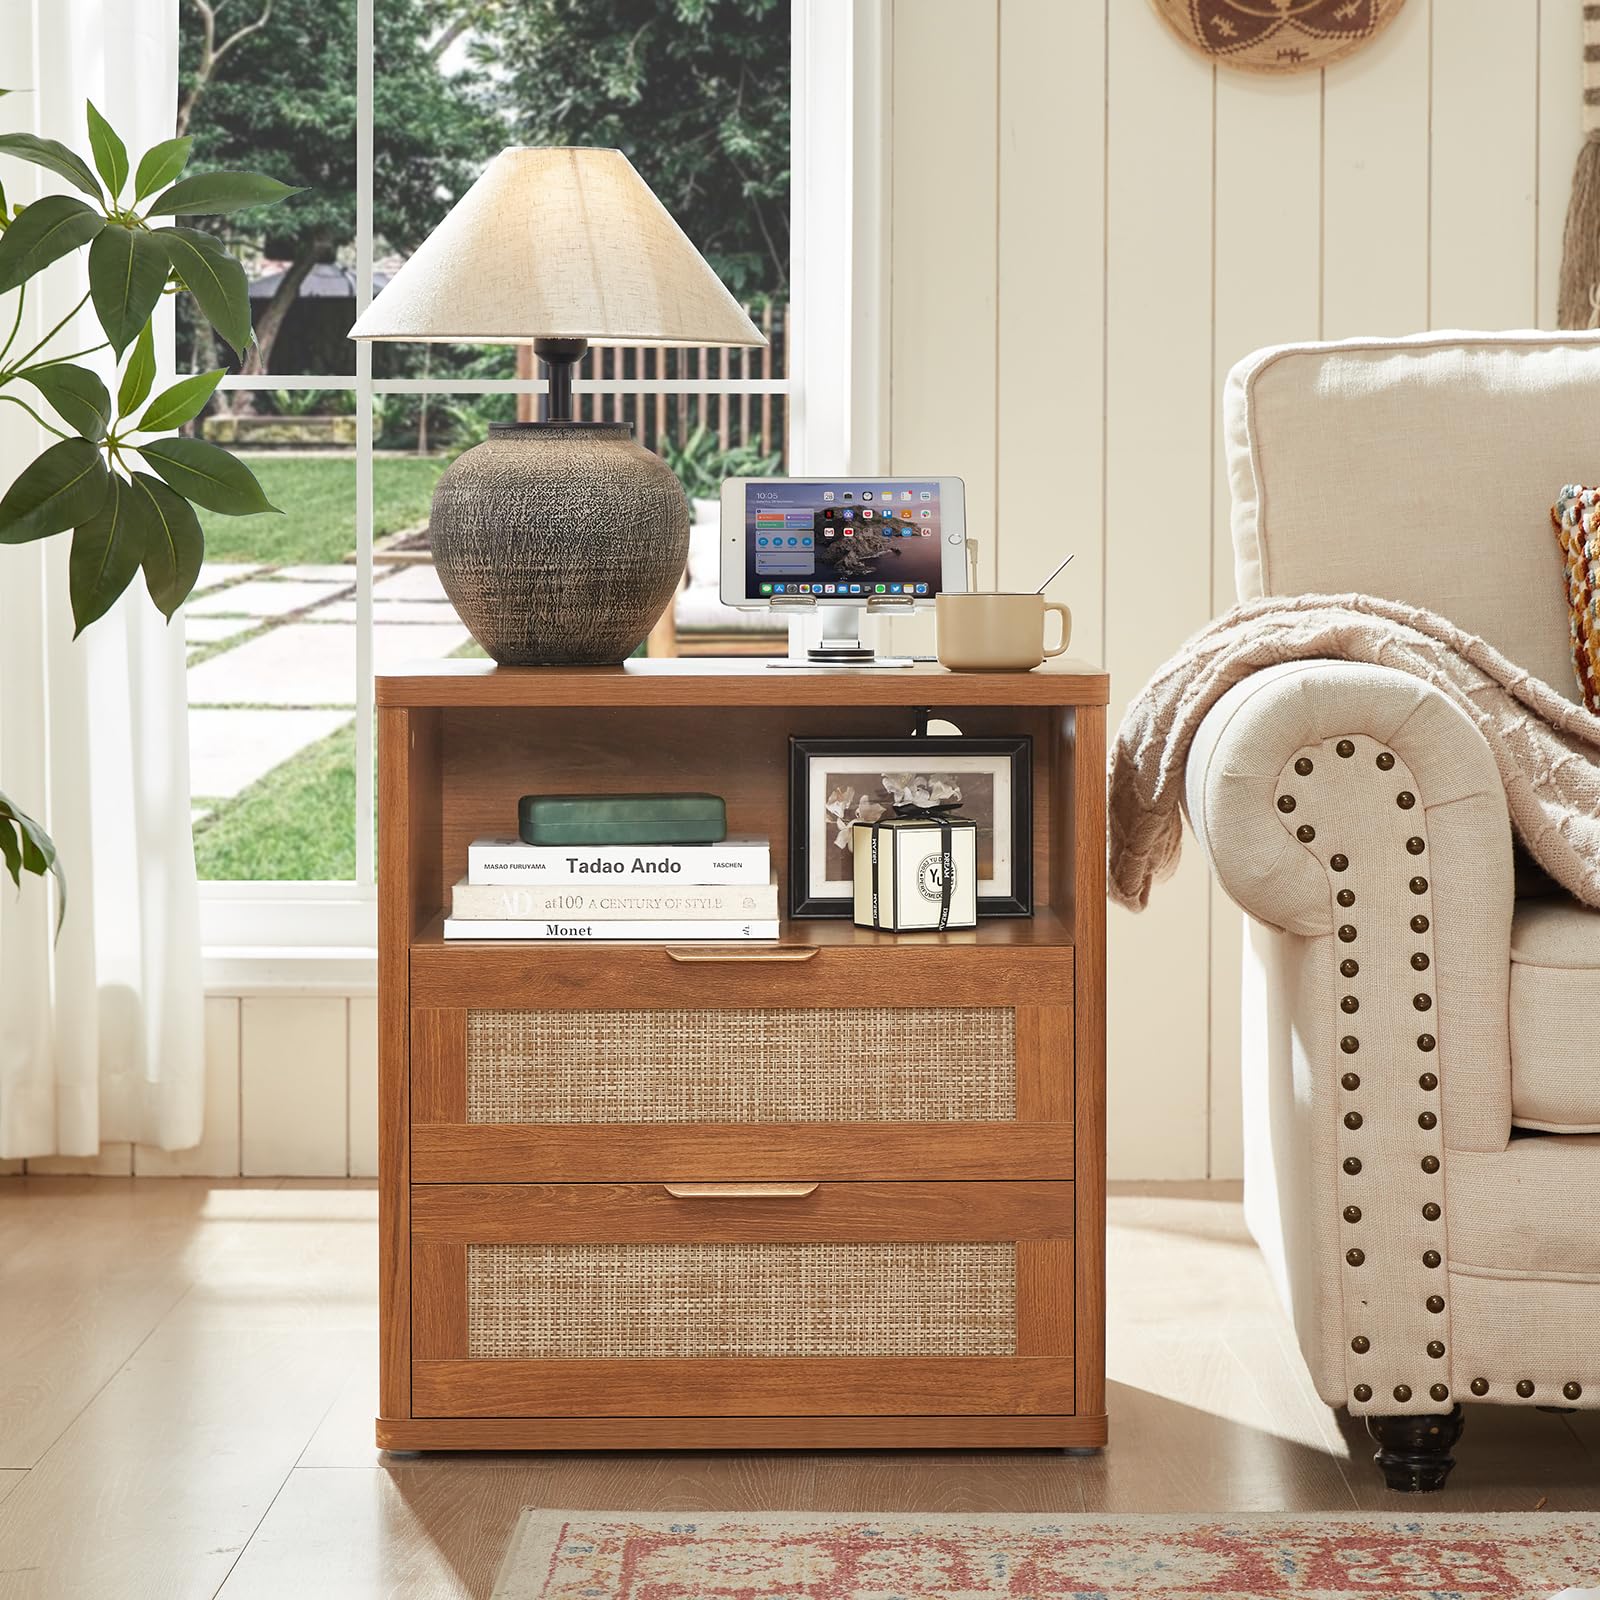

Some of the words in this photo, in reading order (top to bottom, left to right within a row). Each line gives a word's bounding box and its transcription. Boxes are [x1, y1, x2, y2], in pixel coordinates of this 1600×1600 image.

[566, 857, 625, 874] Tadao
[630, 857, 682, 874] Ando
[588, 899, 598, 909] A
[599, 898, 662, 909] CENTURY
[664, 898, 682, 909] OF
[685, 898, 723, 909] STYLE
[546, 924, 592, 936] Monet
